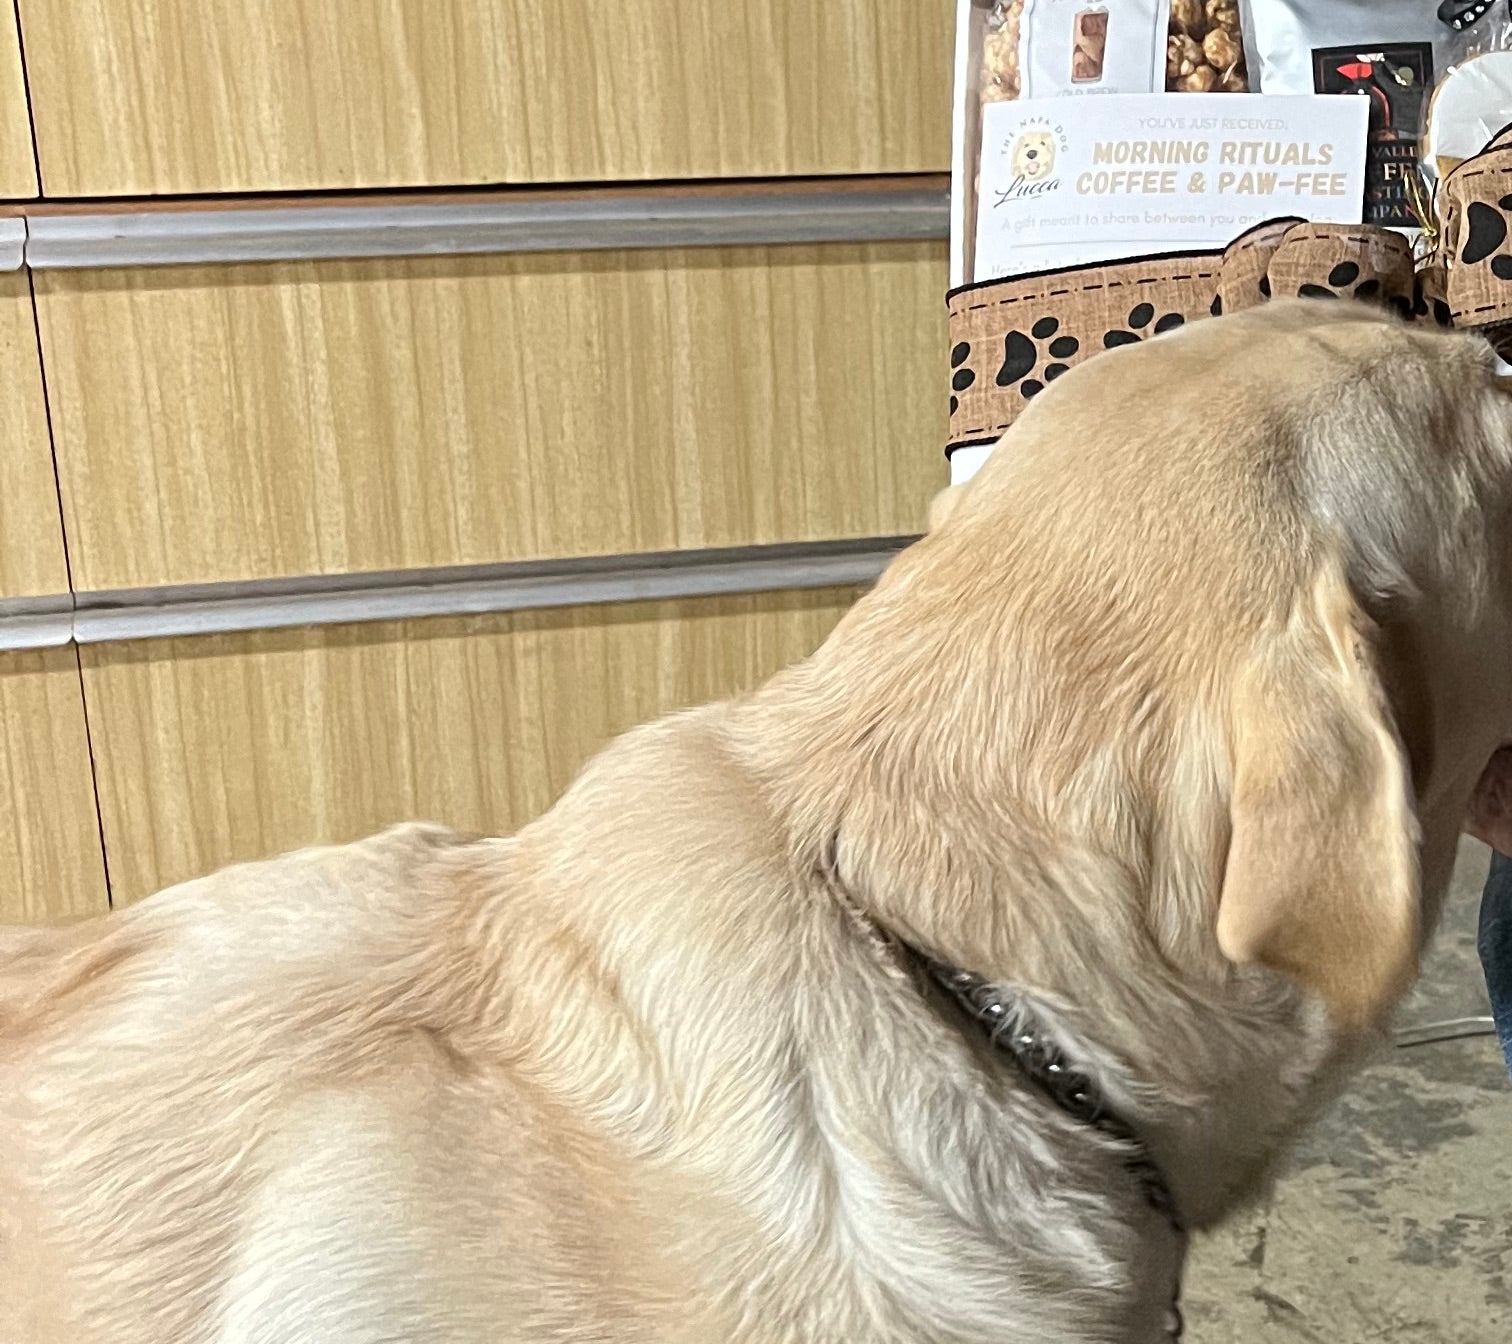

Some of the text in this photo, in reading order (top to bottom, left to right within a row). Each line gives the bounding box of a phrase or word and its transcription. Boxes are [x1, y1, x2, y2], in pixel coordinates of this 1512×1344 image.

[1138, 116, 1185, 130] YOU'VE
[1189, 117, 1218, 130] JUST
[1054, 124, 1069, 153] DOG
[1092, 140, 1334, 166] MORNING RITUALS
[993, 174, 1062, 209] Lucca
[1075, 170, 1178, 196] COFFEE
[1186, 172, 1207, 195] &
[1217, 171, 1348, 196] PAW-FEE
[1039, 214, 1080, 227] meant
[1085, 212, 1099, 225] to
[1103, 210, 1140, 224] share
[1144, 210, 1206, 225] between
[1210, 215, 1234, 228] you
